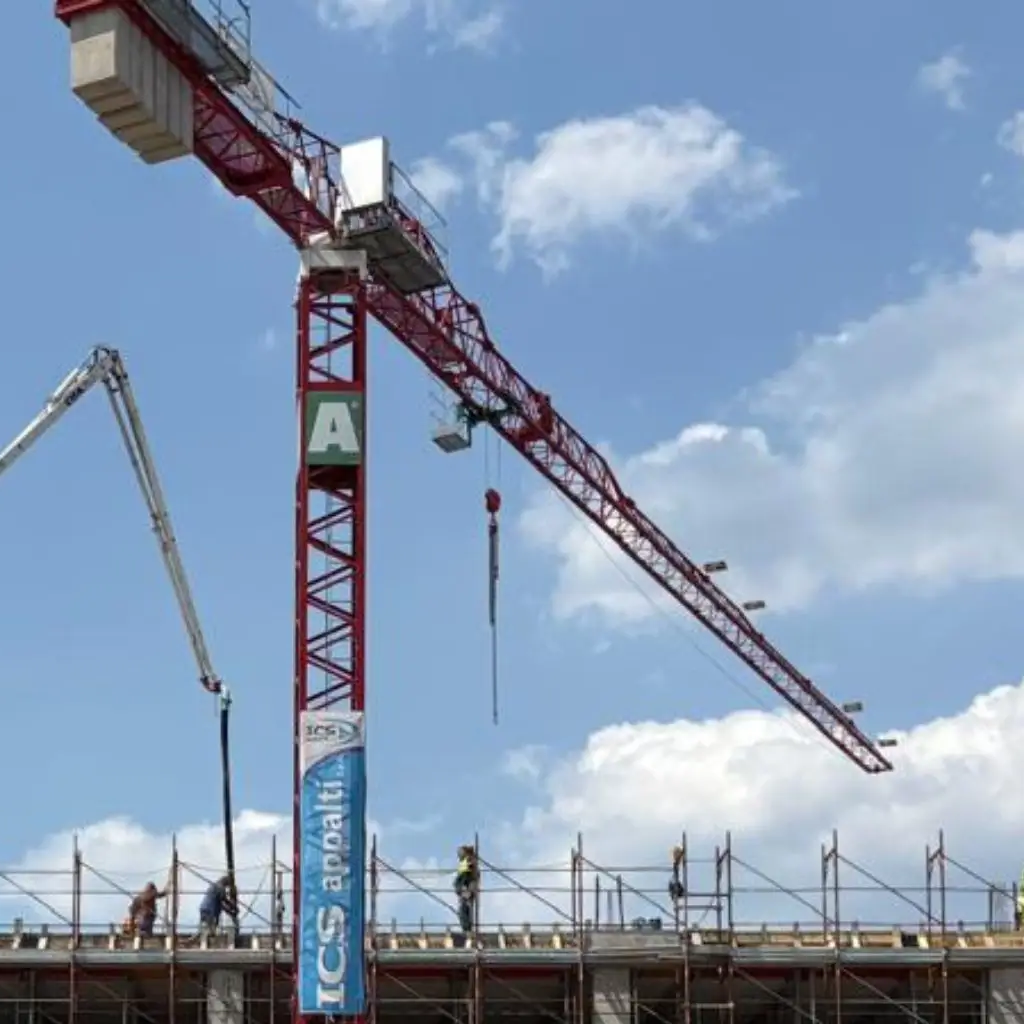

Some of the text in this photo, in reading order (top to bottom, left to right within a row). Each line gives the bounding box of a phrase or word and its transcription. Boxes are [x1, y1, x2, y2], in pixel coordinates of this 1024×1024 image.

[307, 401, 360, 452] A
[314, 780, 351, 892] appalti
[316, 904, 347, 1009] ICS
